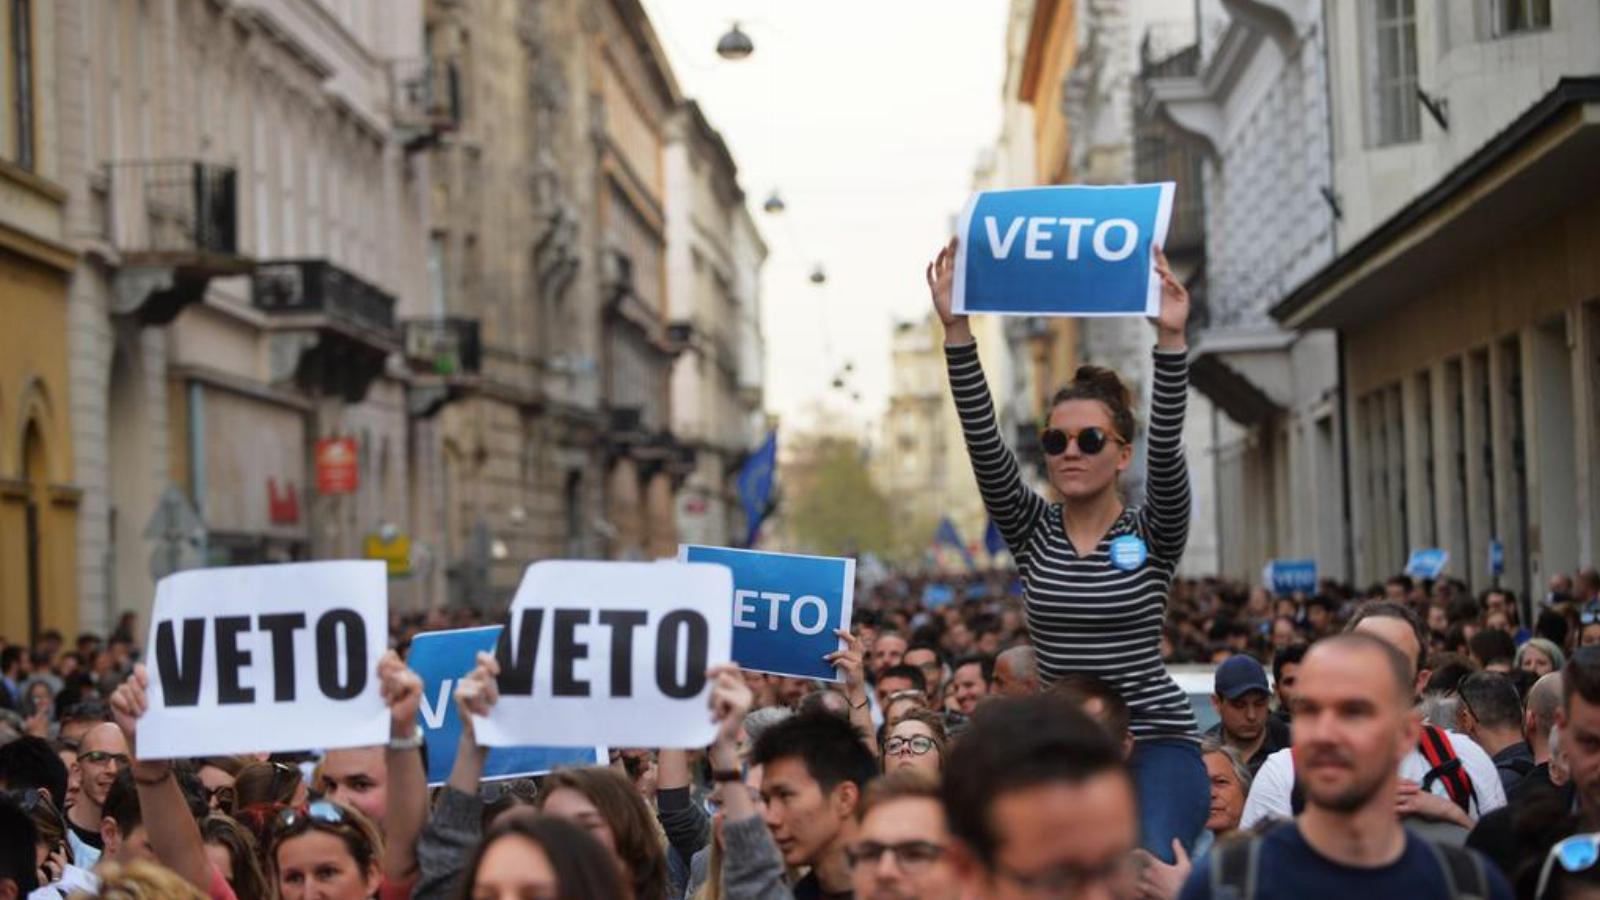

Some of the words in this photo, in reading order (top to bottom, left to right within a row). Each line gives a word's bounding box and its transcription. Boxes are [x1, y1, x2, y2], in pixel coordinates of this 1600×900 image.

[984, 216, 1139, 262] VETO
[733, 589, 828, 635] ETO
[156, 608, 368, 708] VETO
[496, 608, 709, 699] VETO
